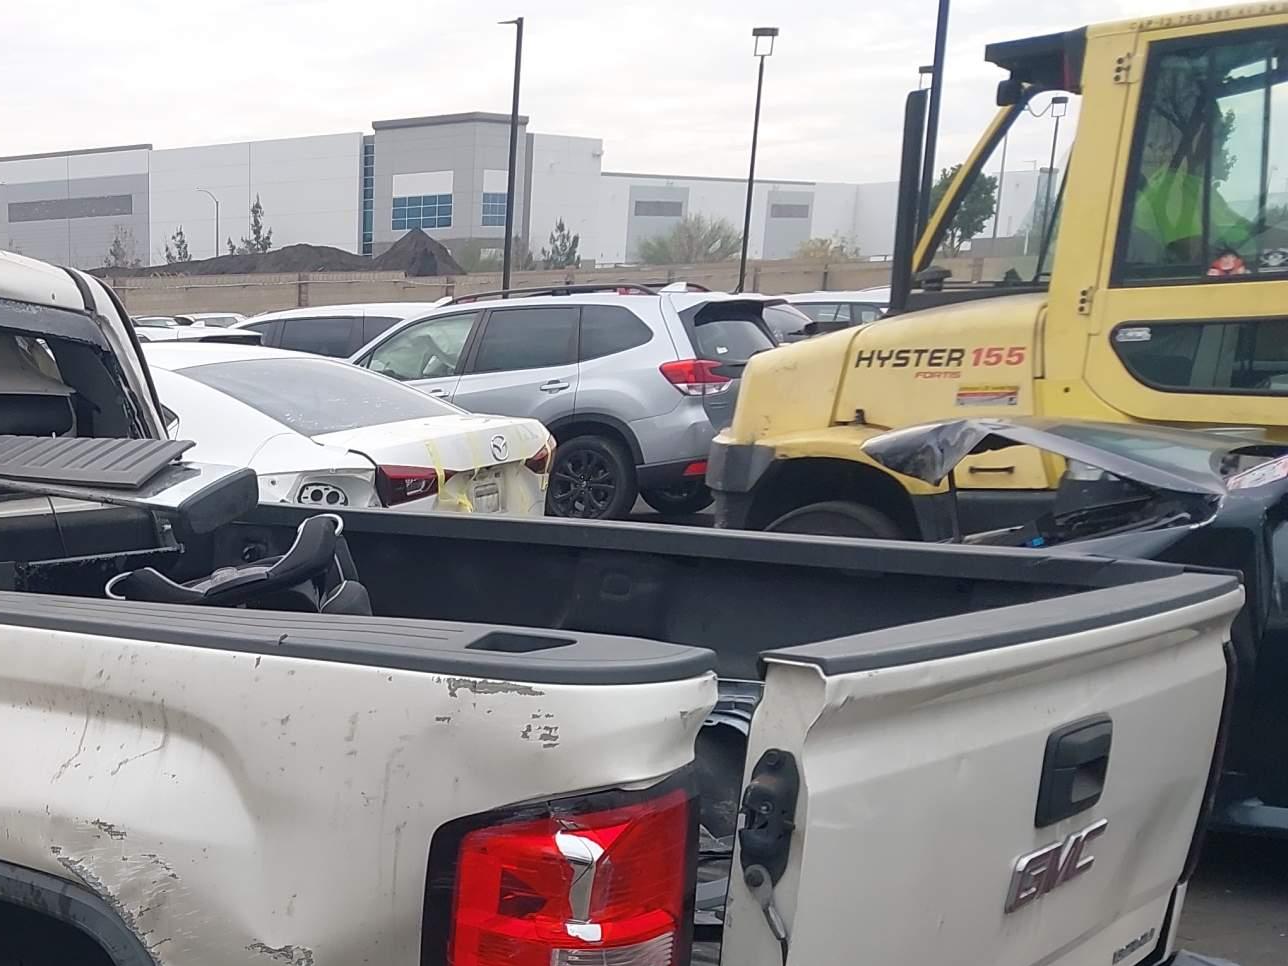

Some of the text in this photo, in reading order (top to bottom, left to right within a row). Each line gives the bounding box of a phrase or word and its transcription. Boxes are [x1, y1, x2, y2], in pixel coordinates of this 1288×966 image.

[854, 346, 1027, 368] HYSTER 155
[914, 370, 962, 379] FORTIS
[1004, 818, 1109, 914] GMC
